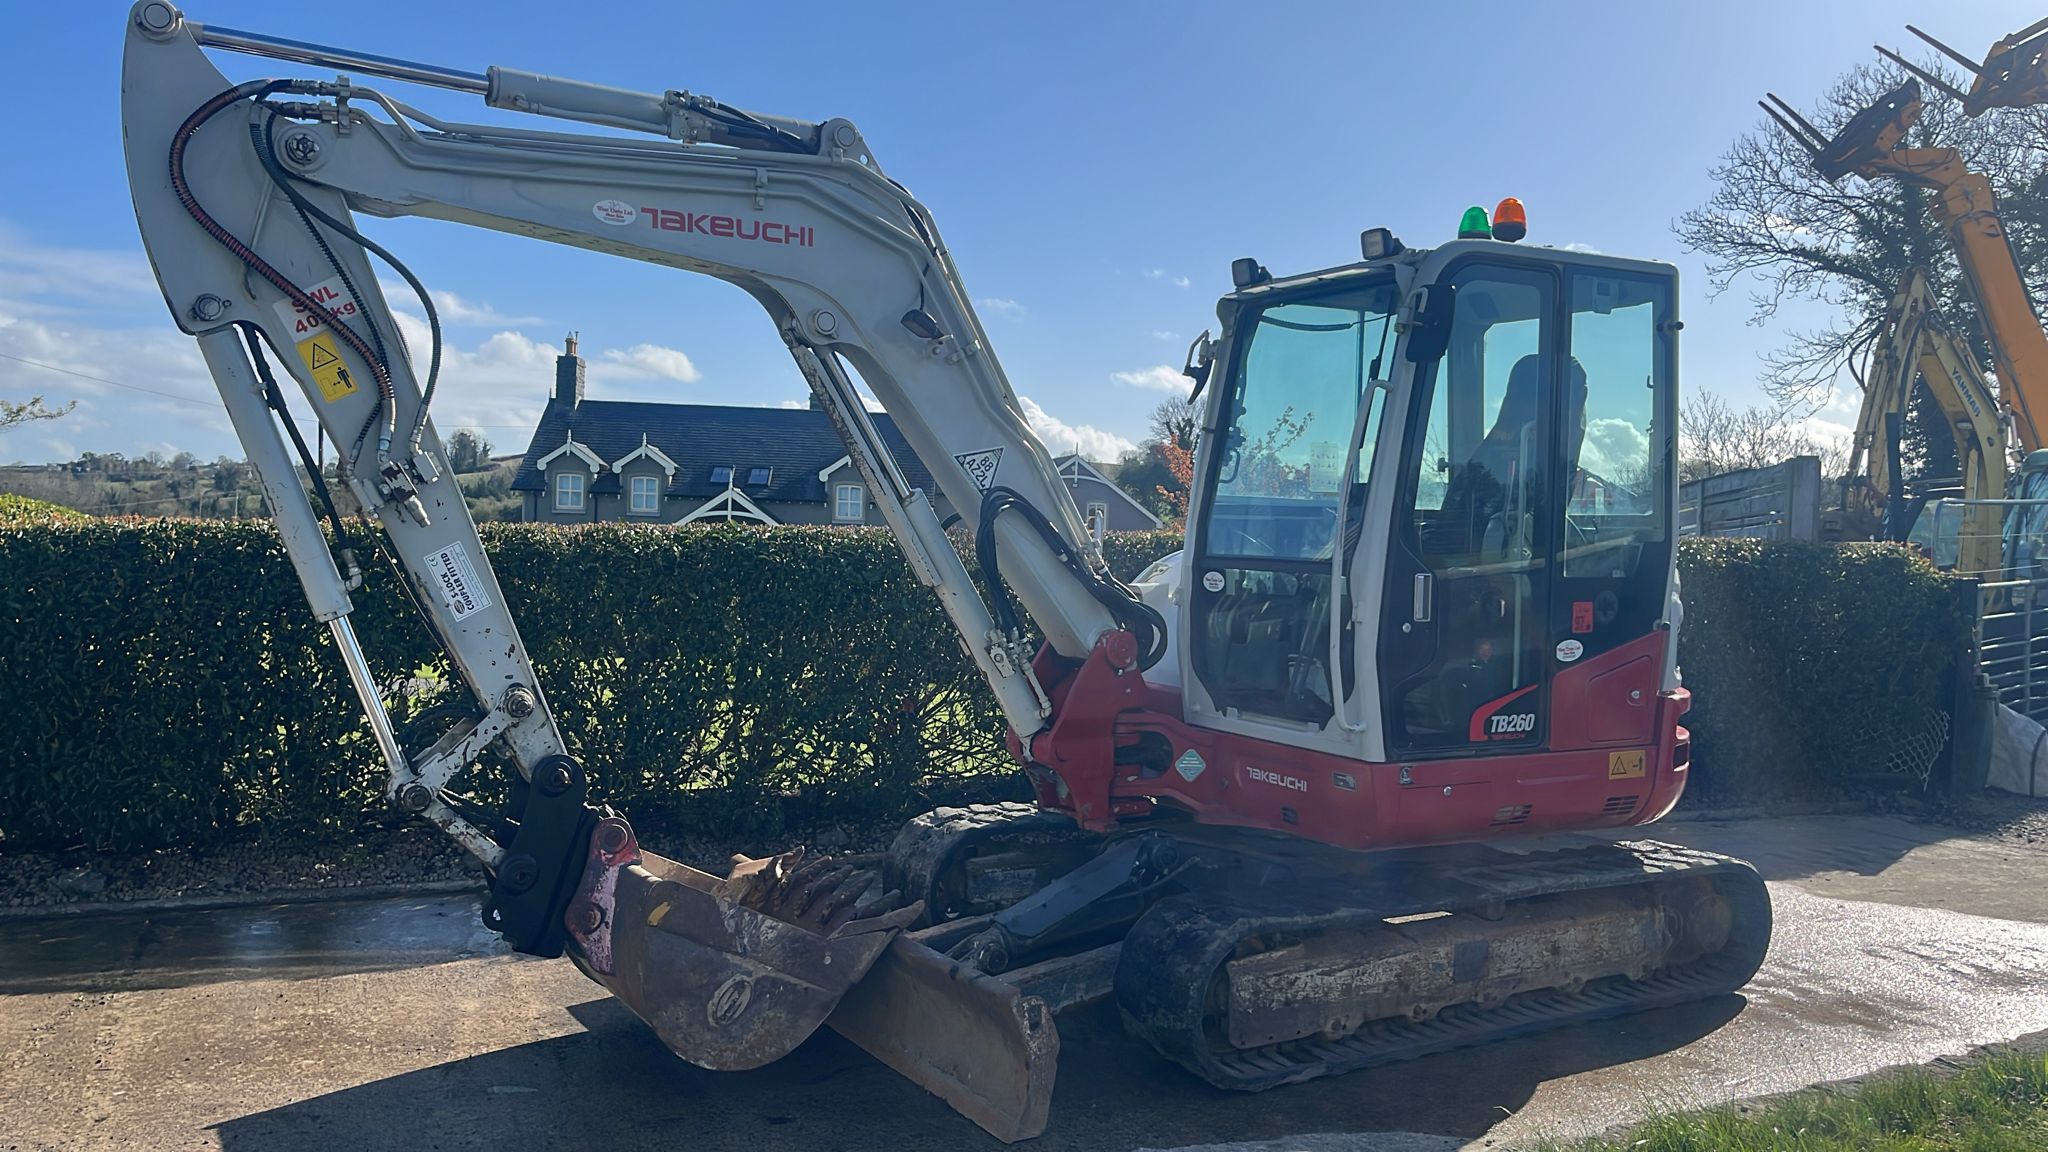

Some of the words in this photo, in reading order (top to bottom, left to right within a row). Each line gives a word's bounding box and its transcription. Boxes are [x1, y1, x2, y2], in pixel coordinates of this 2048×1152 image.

[641, 207, 814, 247] TAKEUCHI
[295, 301, 356, 333] 40kg
[1952, 366, 1981, 417] YANMAR
[980, 456, 994, 472] 88
[440, 552, 458, 578] FITTED
[453, 577, 475, 611] COUPLER
[1491, 713, 1536, 733] TB260
[1246, 766, 1308, 793] TAKEUCHI
